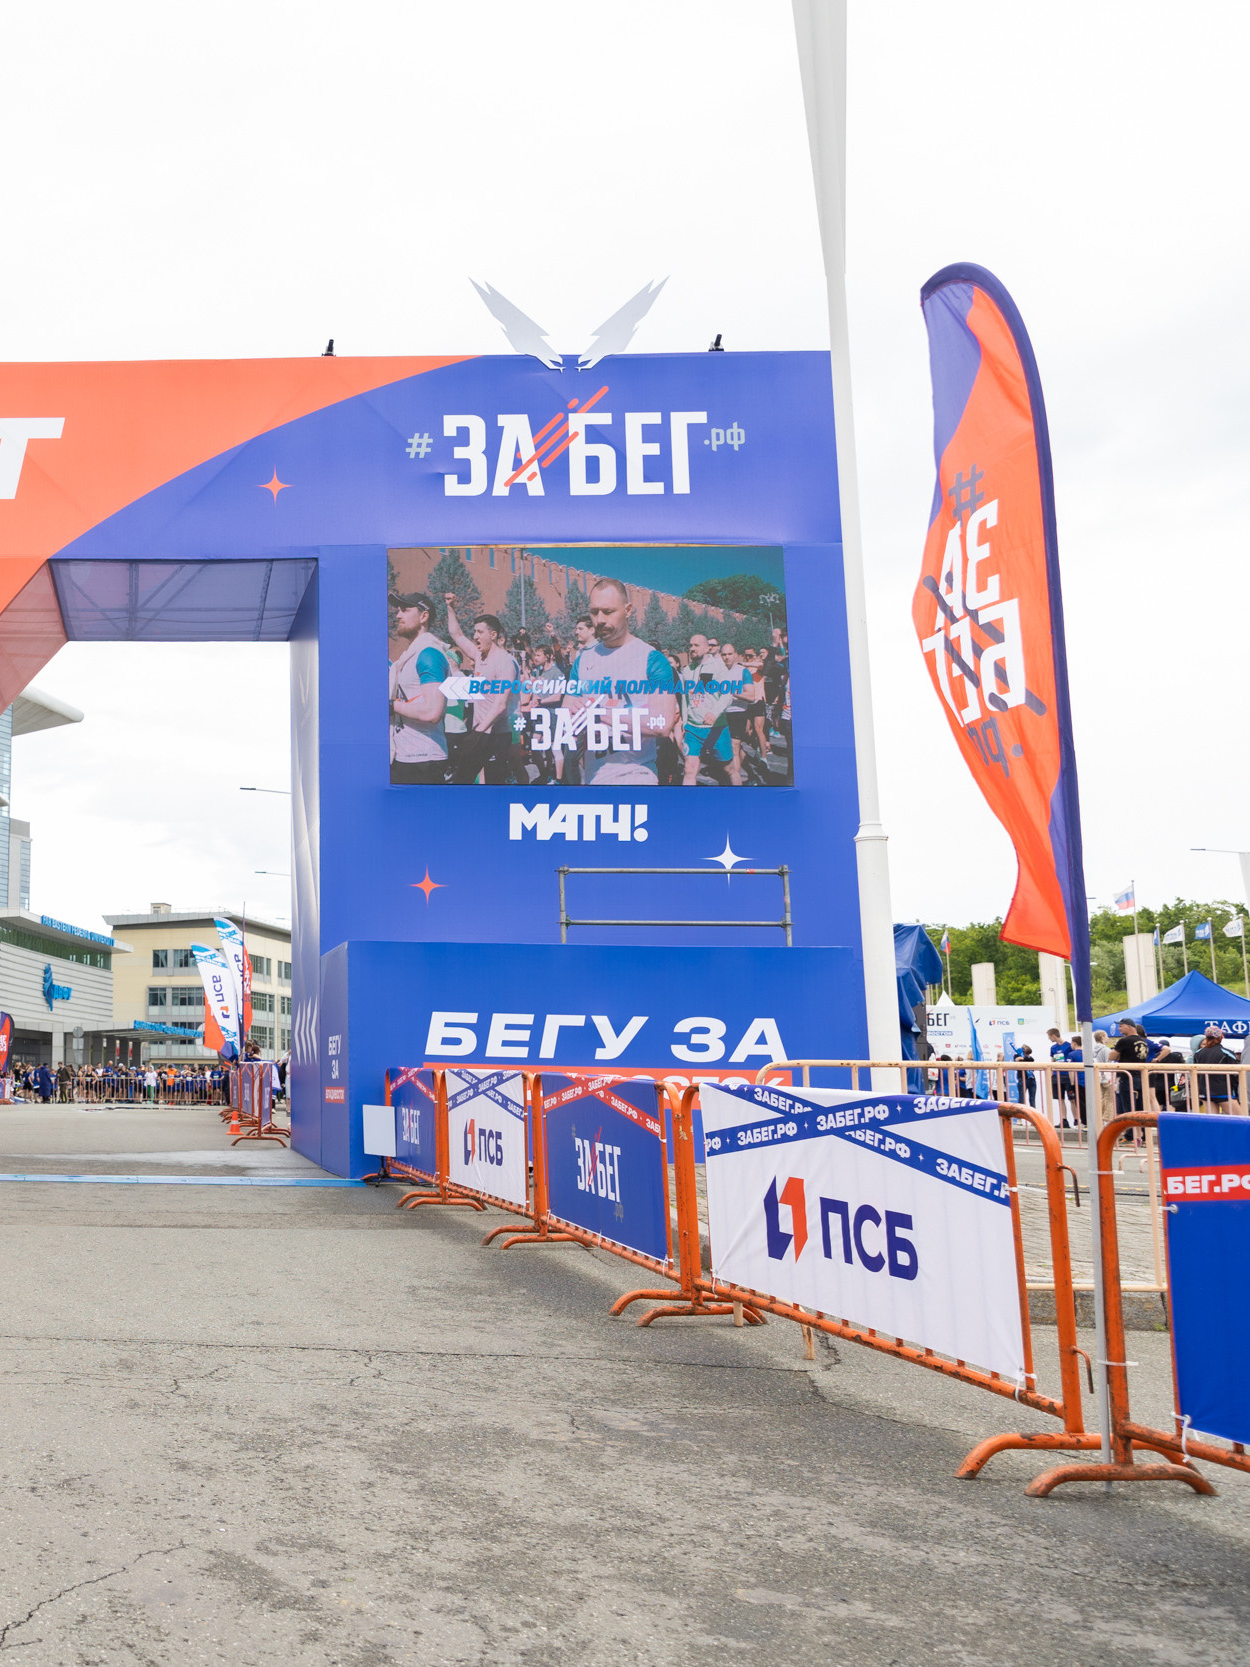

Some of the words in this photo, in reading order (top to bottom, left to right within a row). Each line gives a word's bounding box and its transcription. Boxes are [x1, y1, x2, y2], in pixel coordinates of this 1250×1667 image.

[469, 676, 613, 695] ВСЕРОССИЙСКИЙ
[615, 679, 744, 695] ПОЛУМАРАФОН
[509, 803, 649, 843] МАТЧ!
[328, 1034, 342, 1056] БЕГУ
[424, 1011, 650, 1060] БЕГУ
[670, 1016, 789, 1063] ЗА
[331, 1059, 340, 1079] ЗА
[610, 1096, 638, 1120] ЗАБЕГ.РФ
[737, 1121, 798, 1146] ЗАБЕГ.РФ
[816, 1103, 890, 1131] ЗАБЕГ.РФ
[478, 1127, 504, 1167] ПСБ
[1163, 1173, 1250, 1195] БЕГ.Р
[819, 1195, 919, 1282] ПСБ
